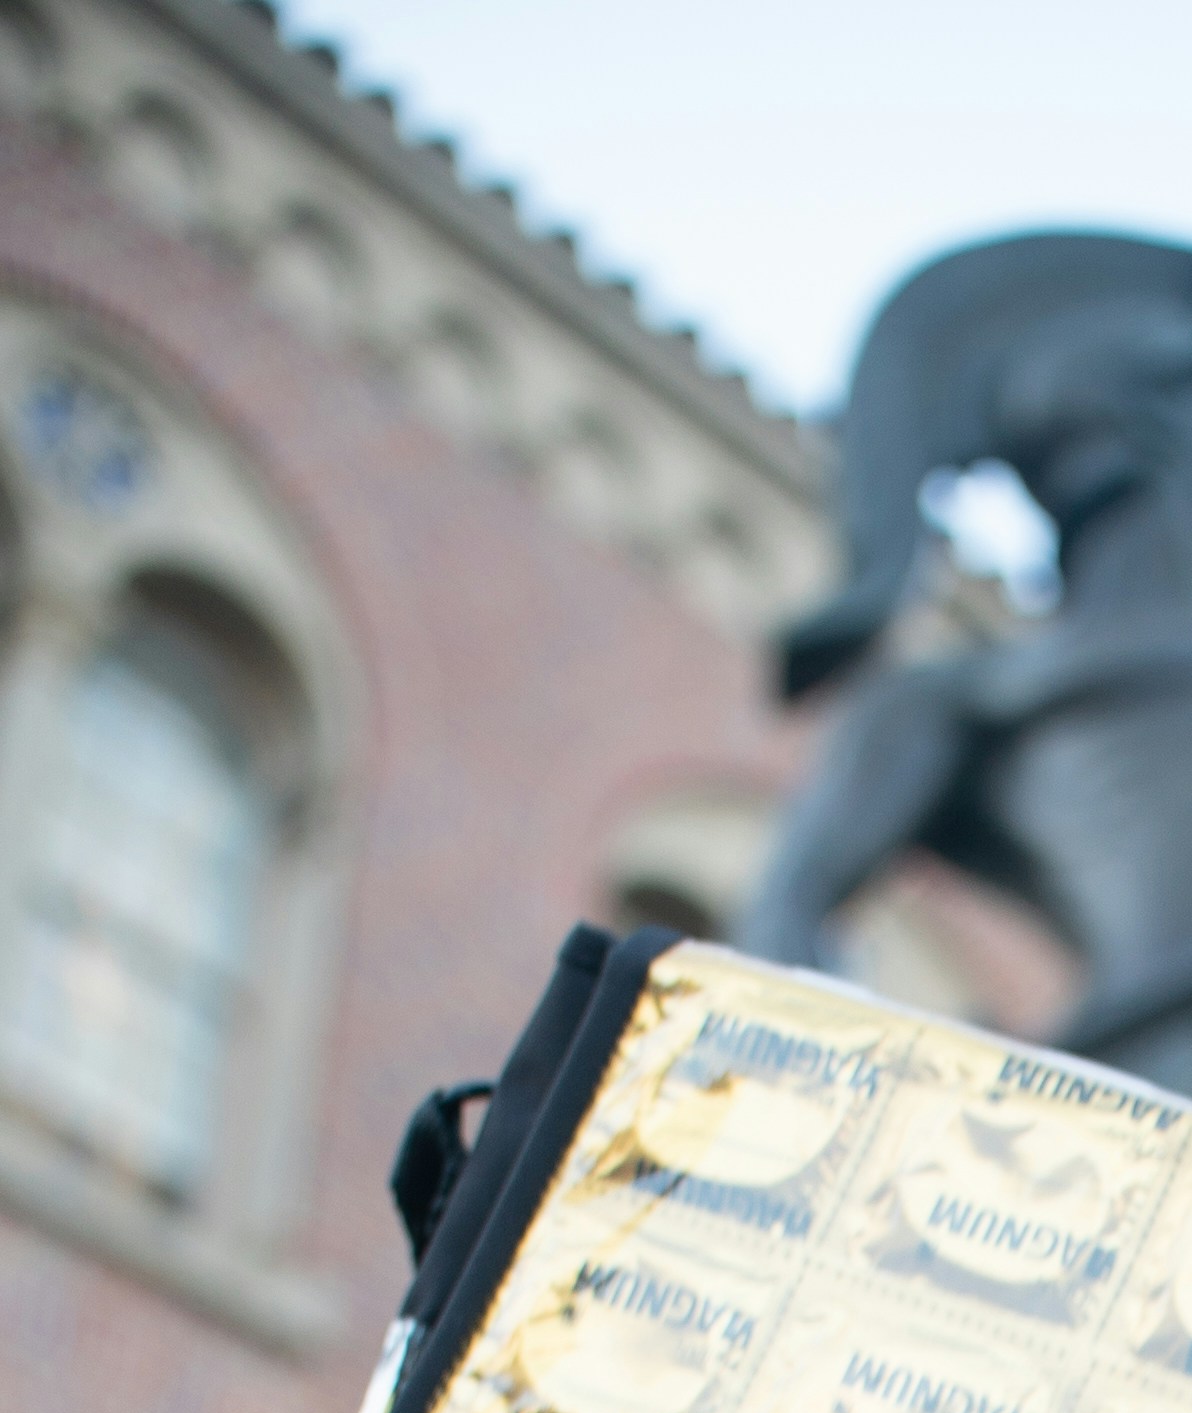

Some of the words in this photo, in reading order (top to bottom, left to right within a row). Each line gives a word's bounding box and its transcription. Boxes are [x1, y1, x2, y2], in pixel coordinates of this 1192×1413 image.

[694, 1011, 879, 1100] MAGNUM
[927, 1194, 1118, 1279] MAGNUM
[574, 1259, 755, 1351] MAGNUM
